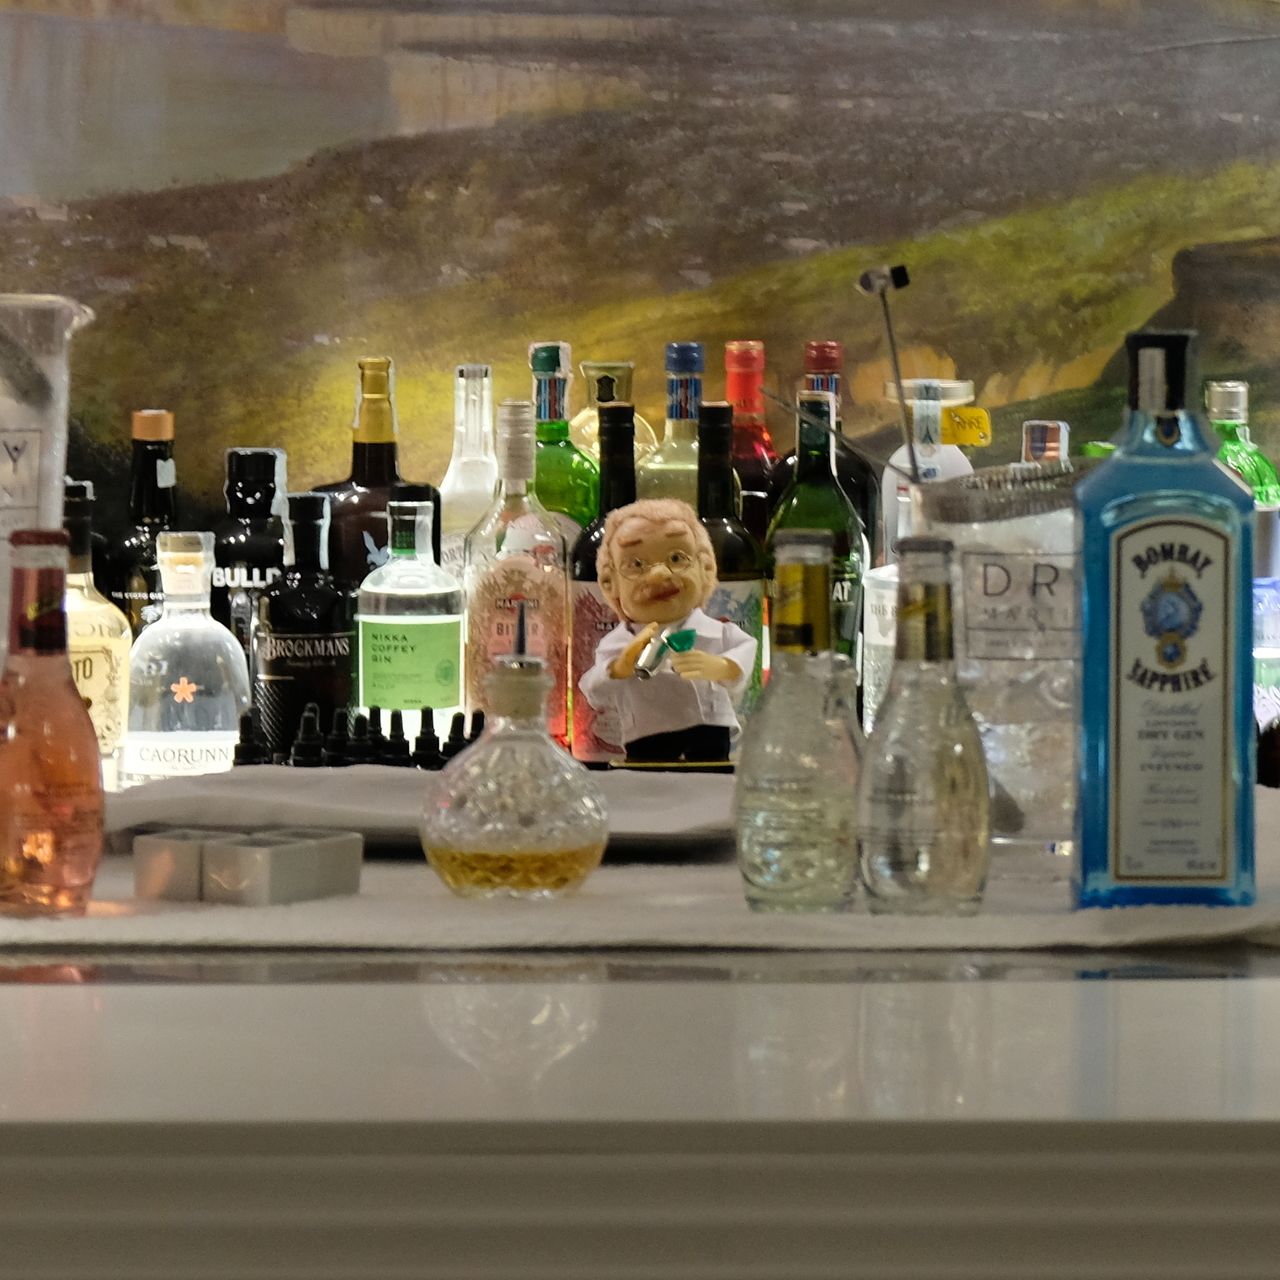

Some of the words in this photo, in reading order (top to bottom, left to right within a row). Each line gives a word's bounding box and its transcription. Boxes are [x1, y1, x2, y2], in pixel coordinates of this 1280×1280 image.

[1131, 542, 1213, 580] BOMBAY
[371, 633, 408, 643] NIKKA
[266, 636, 350, 661] BROCKMANS
[371, 644, 417, 654] COFFEY
[371, 655, 392, 664] GIN
[1126, 657, 1217, 693] SAPPHIRE
[139, 747, 230, 765] CAORUNN
